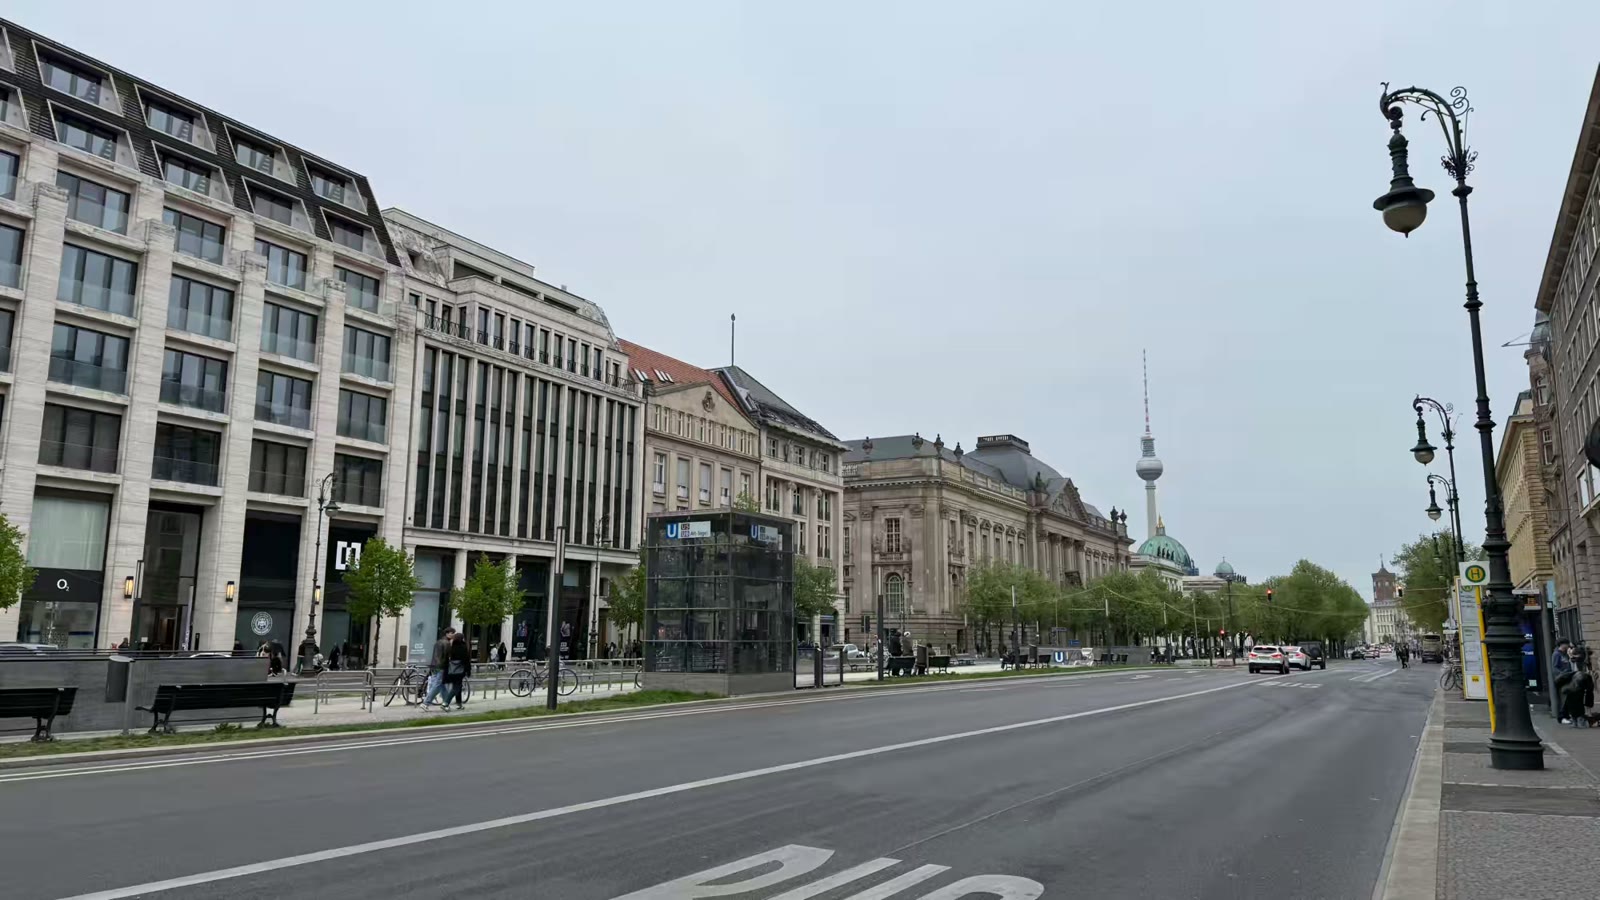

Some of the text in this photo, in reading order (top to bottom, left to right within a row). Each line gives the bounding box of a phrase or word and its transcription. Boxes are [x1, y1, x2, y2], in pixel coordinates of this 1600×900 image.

[667, 523, 677, 538] U
[751, 524, 758, 539] U
[1470, 567, 1480, 580] H
[1055, 651, 1064, 663] U
